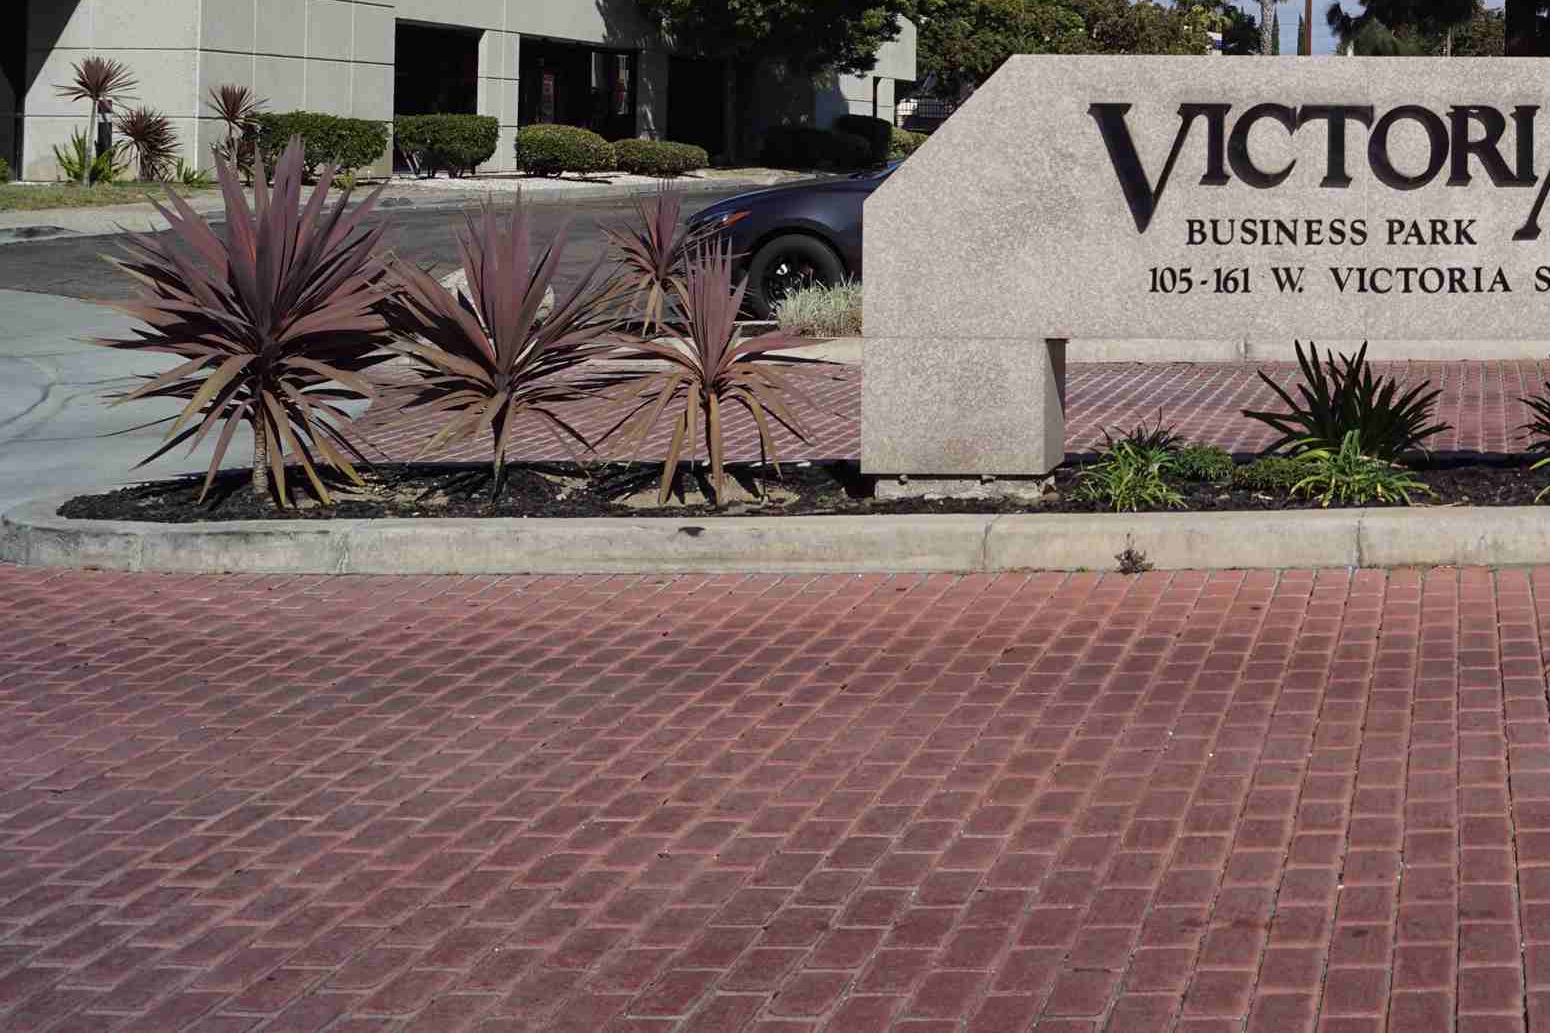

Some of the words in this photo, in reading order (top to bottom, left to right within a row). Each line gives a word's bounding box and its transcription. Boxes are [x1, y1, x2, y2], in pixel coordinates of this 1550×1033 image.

[1186, 219, 1368, 246] BUSINESS
[1386, 219, 1477, 246] PARK
[1149, 267, 1251, 294] 105-161
[1271, 267, 1304, 293] W.
[1329, 266, 1513, 293] VICTORIA
